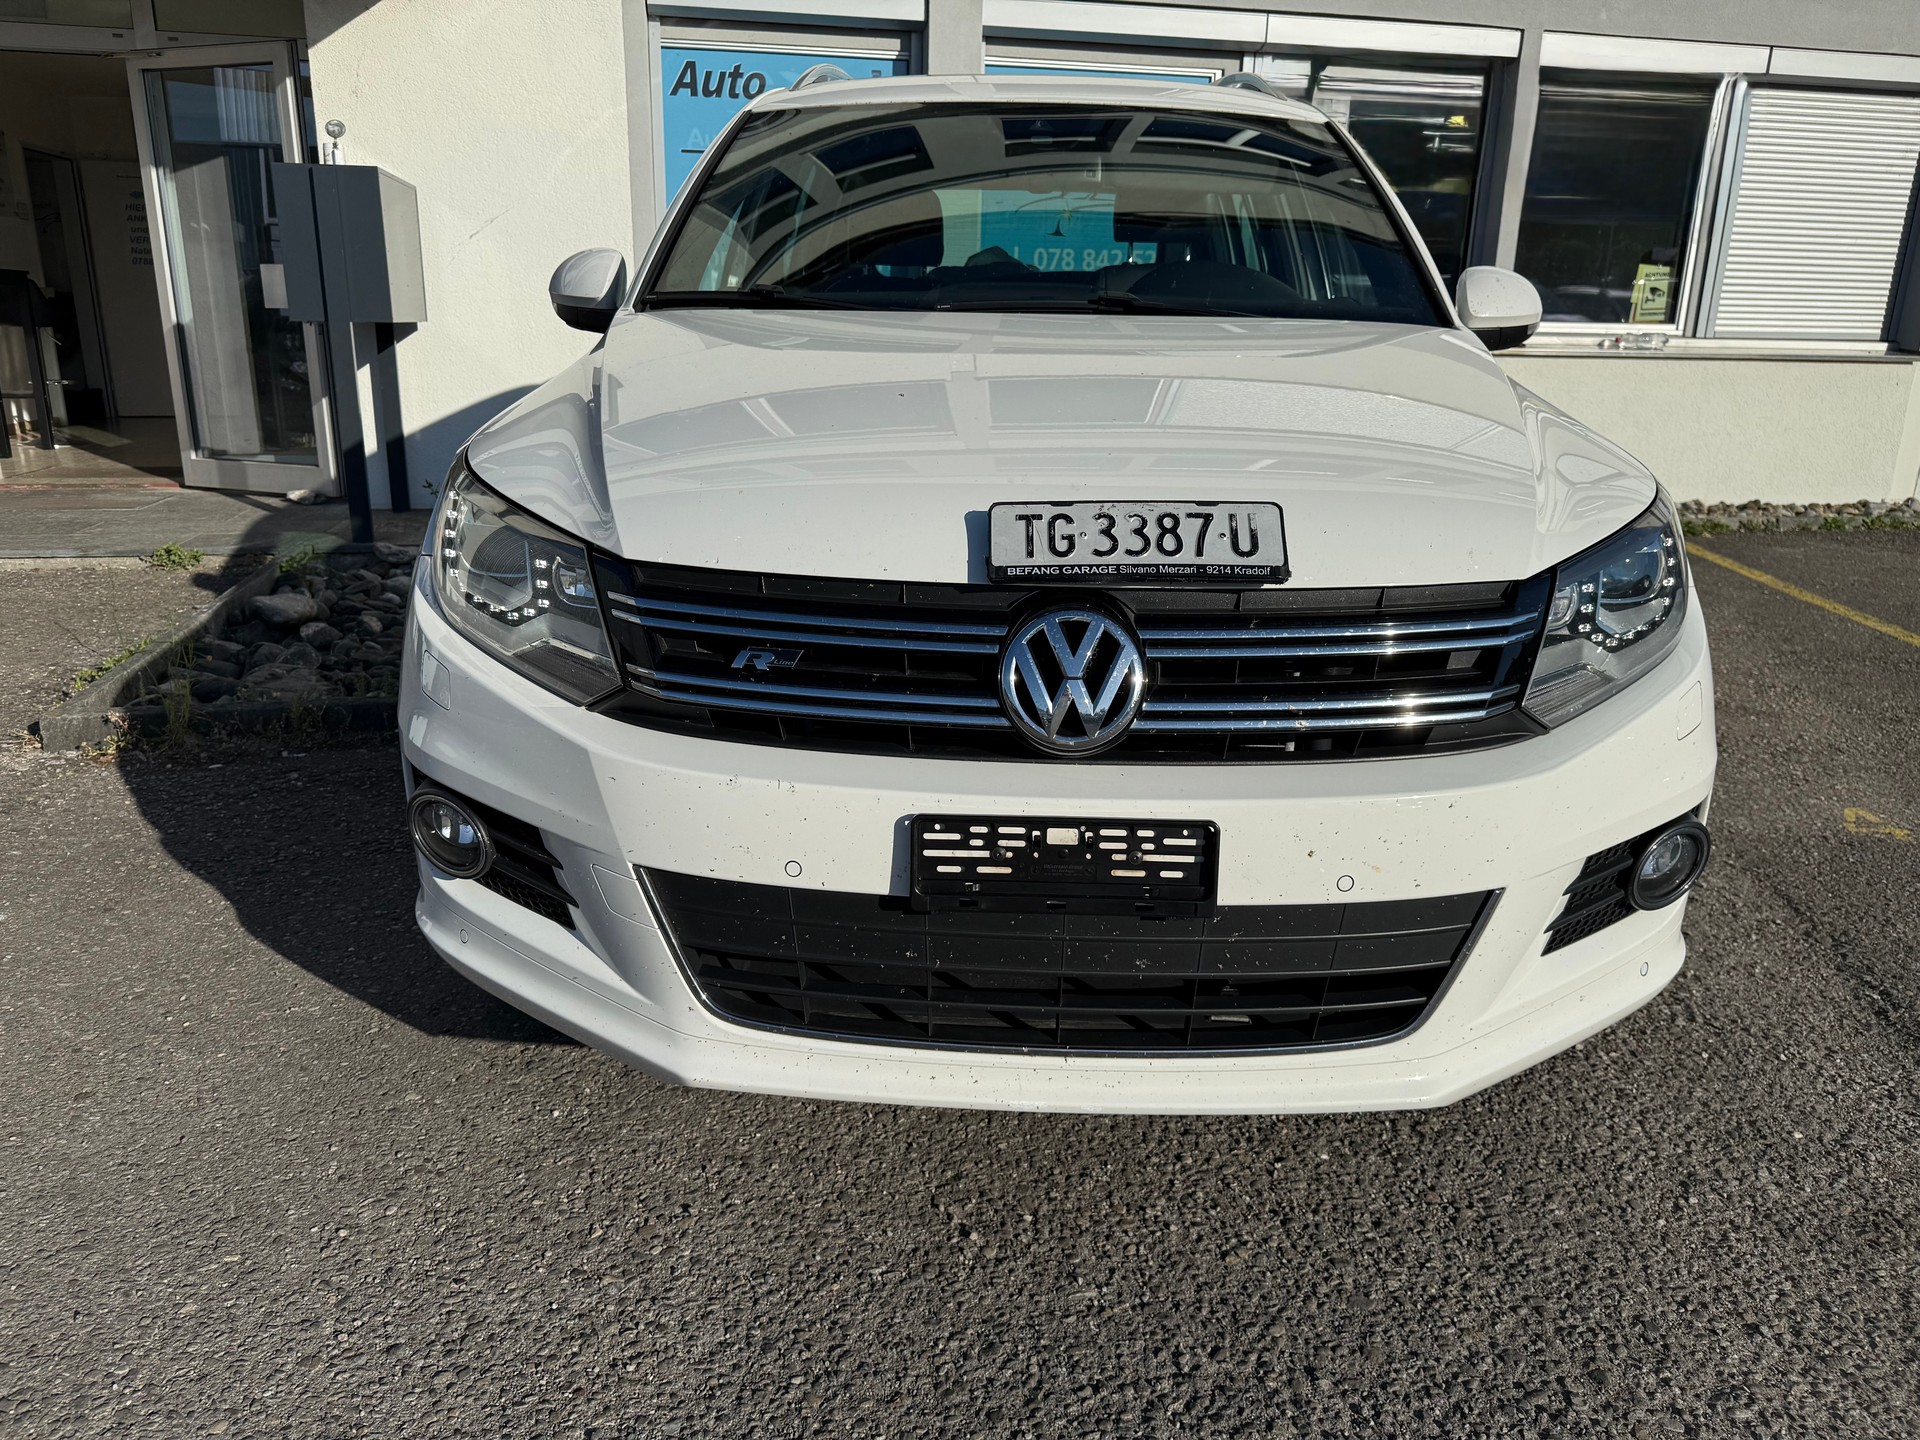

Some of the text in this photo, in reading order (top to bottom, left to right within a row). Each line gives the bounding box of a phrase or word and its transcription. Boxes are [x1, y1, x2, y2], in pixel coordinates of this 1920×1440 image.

[669, 59, 767, 100] Auto
[1033, 247, 1075, 271] 078
[1007, 566, 1059, 576] BEFANG
[1062, 565, 1117, 575] GARAGE
[1119, 565, 1156, 574] Silvano
[1159, 565, 1197, 574] Merzari
[1206, 565, 1232, 575] 9214
